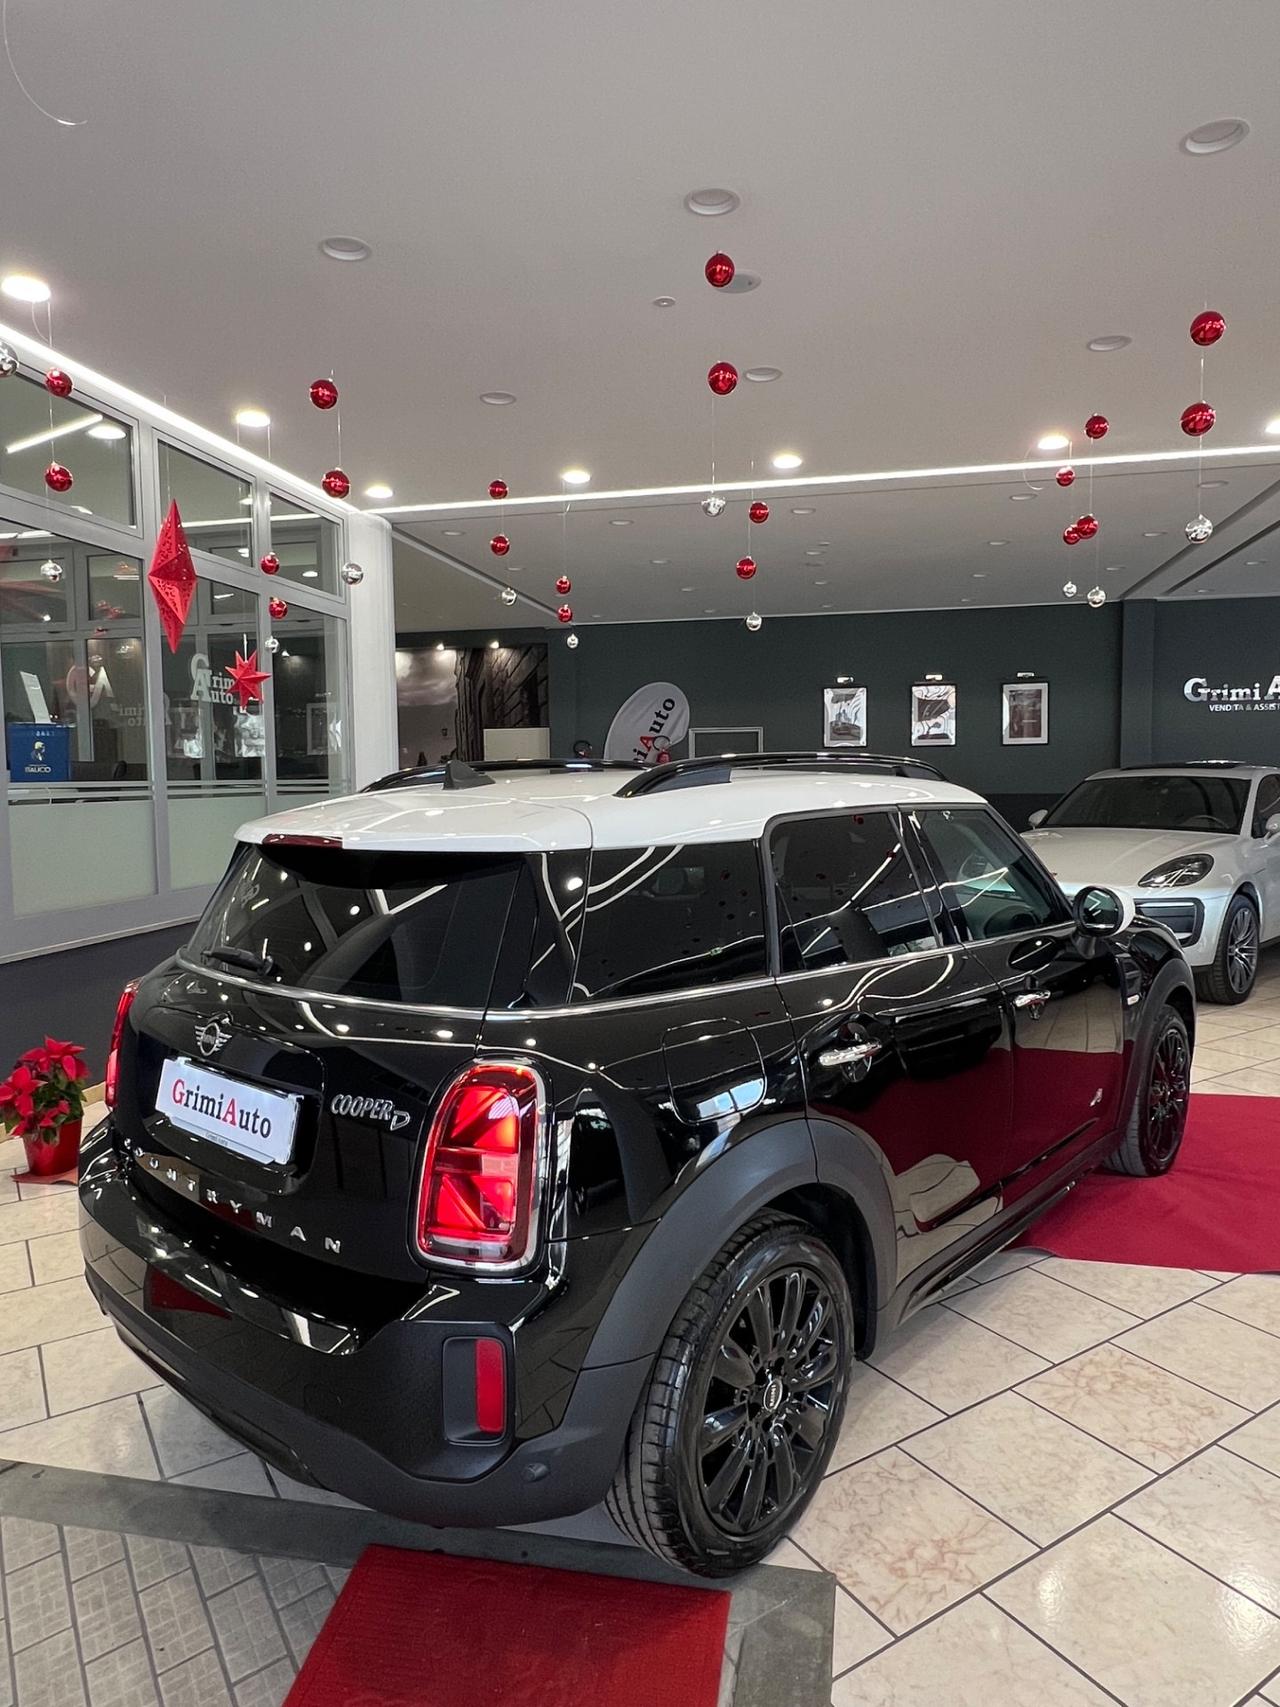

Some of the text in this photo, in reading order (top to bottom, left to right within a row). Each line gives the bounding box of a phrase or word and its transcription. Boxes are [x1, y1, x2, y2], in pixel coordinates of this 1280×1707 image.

[1209, 703, 1244, 712] VENDTA
[172, 1078, 272, 1139] GrimiAuto
[331, 1093, 411, 1131] COOPER D
